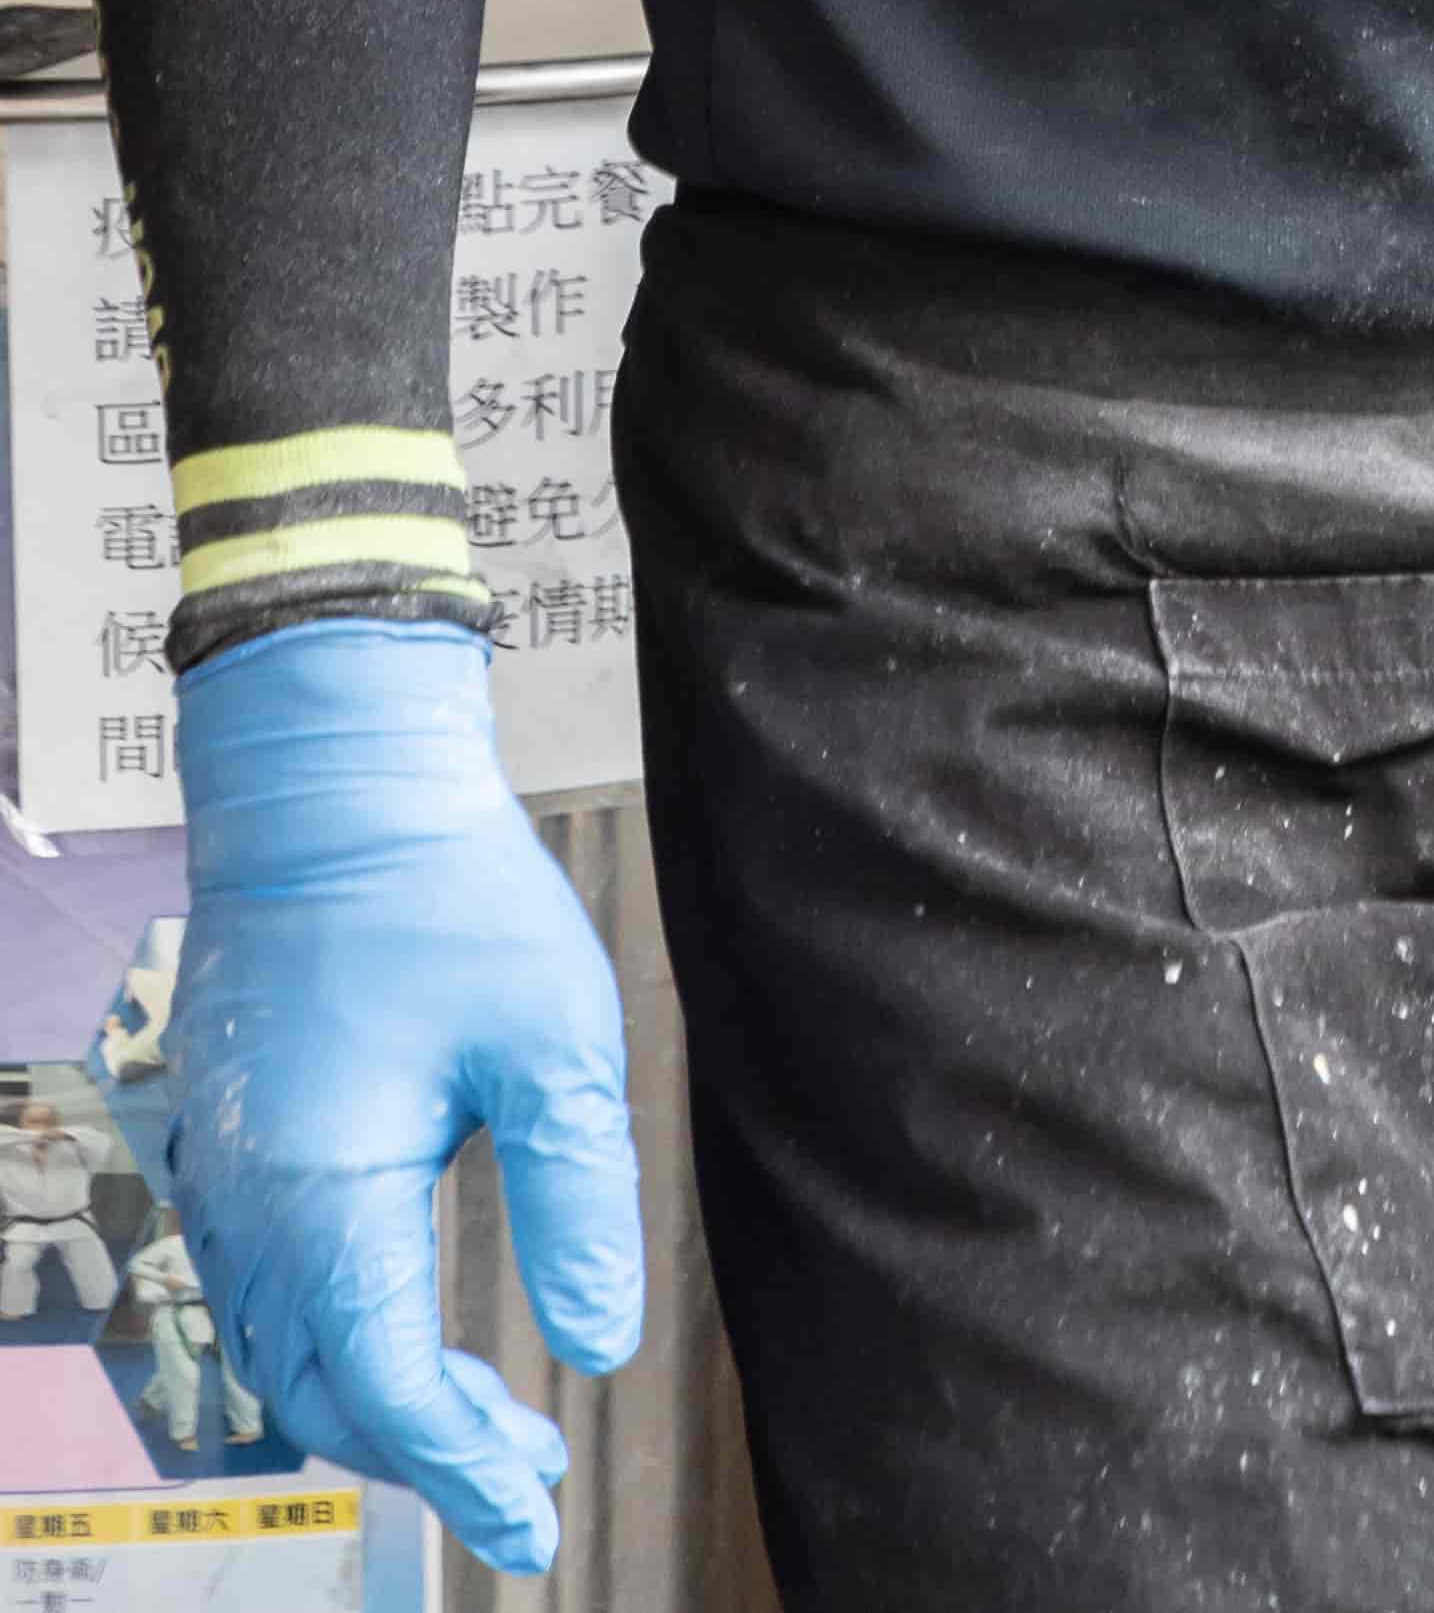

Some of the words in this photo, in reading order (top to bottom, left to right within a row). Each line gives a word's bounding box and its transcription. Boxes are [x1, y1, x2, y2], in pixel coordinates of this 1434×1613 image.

[460, 158, 650, 234] 點完餐
[454, 268, 588, 342] 製作
[93, 503, 180, 570] 電
[14, 1513, 94, 1539] 星期五
[150, 1508, 231, 1535] 星期六
[255, 1499, 335, 1529] 星期日
